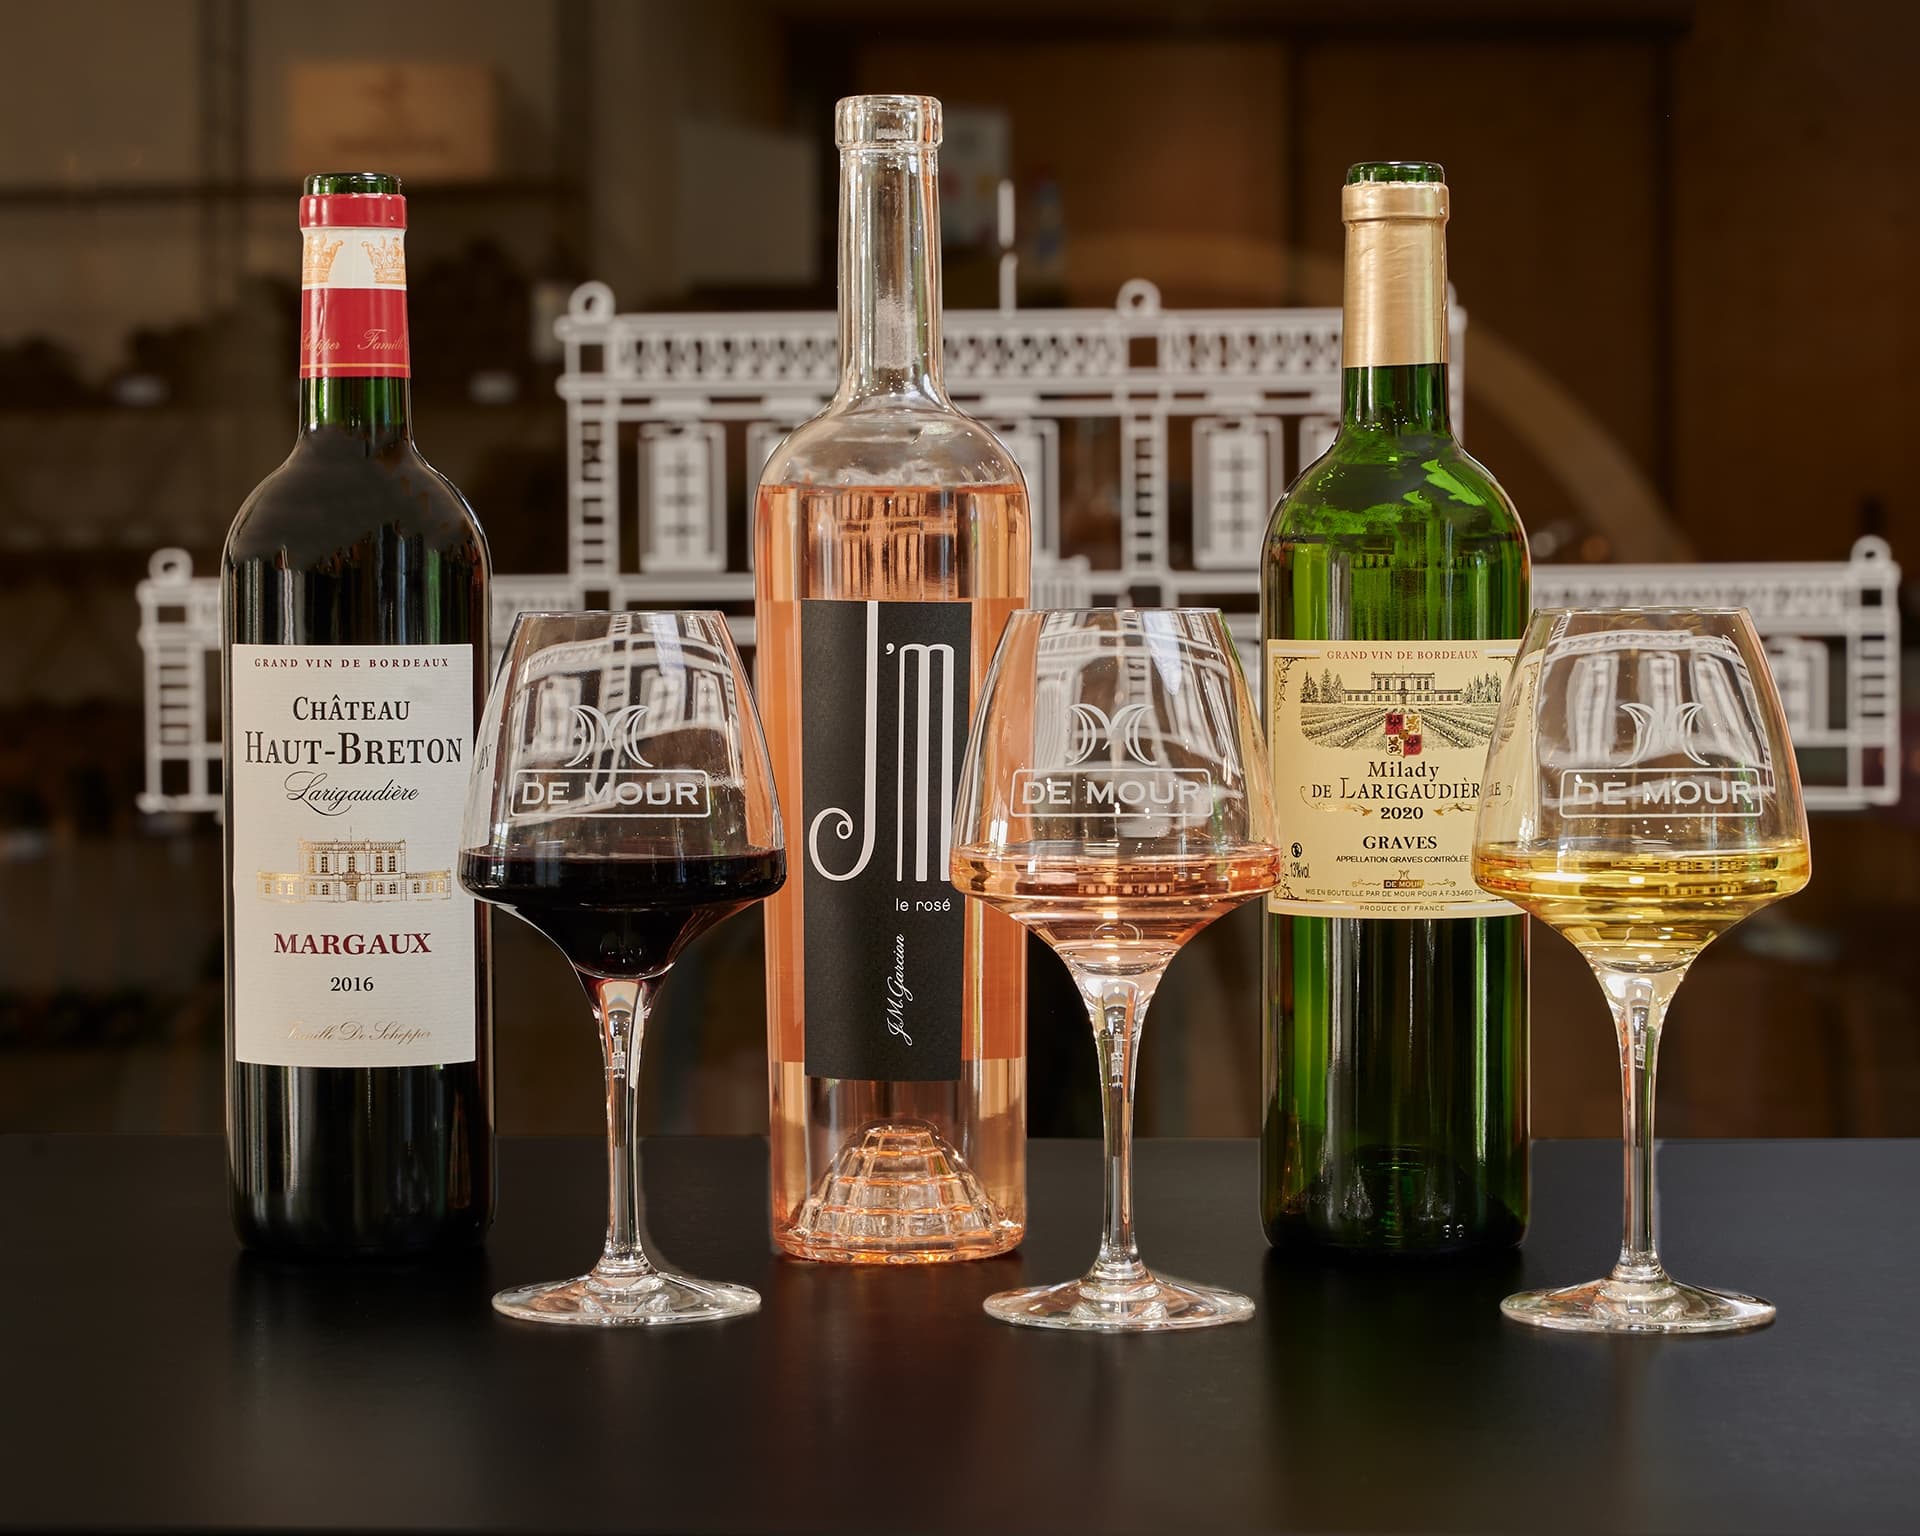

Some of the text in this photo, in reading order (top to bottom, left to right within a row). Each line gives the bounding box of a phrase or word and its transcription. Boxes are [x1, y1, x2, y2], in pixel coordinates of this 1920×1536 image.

[254, 658, 449, 668] GRAND VIN DE BORDEAUX
[1327, 651, 1479, 660] GRAND VIN DE BORDEAUX
[292, 694, 411, 721] CHÂTEAU
[244, 730, 463, 765] HAUT-BRETON
[1368, 761, 1440, 782] Milady
[284, 770, 420, 816] Larigaudière
[521, 782, 699, 805] DE MOUR
[1022, 780, 1200, 805] DE MOUR
[1312, 783, 1332, 799] DE
[1573, 780, 1753, 805] DE MOUR
[1380, 807, 1424, 820] 2020
[1363, 836, 1438, 850] GRAVES
[1336, 855, 1388, 863] APPELLATION
[1389, 855, 1423, 863] GRAVES
[895, 898, 951, 911] le rosé
[1359, 904, 1398, 912] PRODUCE
[1415, 904, 1446, 912] FRANCE
[273, 932, 432, 955] MARGAUX
[330, 976, 374, 992] 2016
